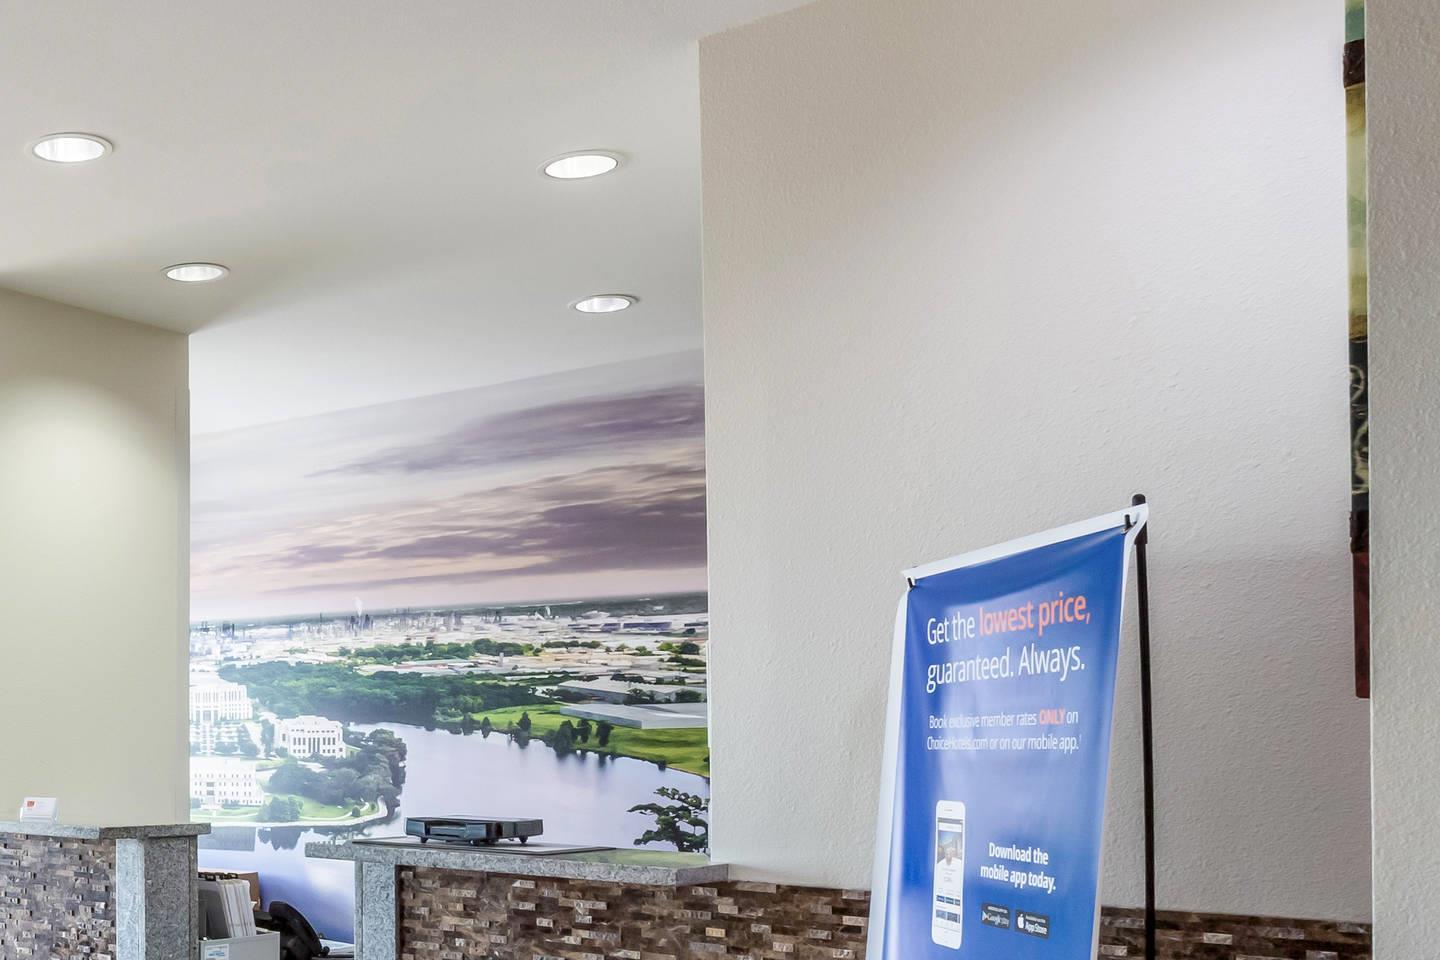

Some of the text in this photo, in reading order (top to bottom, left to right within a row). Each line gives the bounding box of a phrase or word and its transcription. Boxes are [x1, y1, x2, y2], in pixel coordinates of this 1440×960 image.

[927, 591, 1091, 645] Get the lowest price,
[926, 643, 1085, 694] guaranteed. Always.
[929, 713, 948, 729] Book
[981, 711, 1015, 728] member
[1016, 711, 1037, 726] rates
[1040, 707, 1065, 725] ONLY
[1066, 711, 1079, 725] on
[989, 738, 998, 750] or
[1000, 737, 1010, 750] on
[1011, 737, 1025, 750] our
[1027, 732, 1058, 750] mobile
[988, 842, 1049, 866] Download the
[980, 864, 1057, 895] mobile app today.
